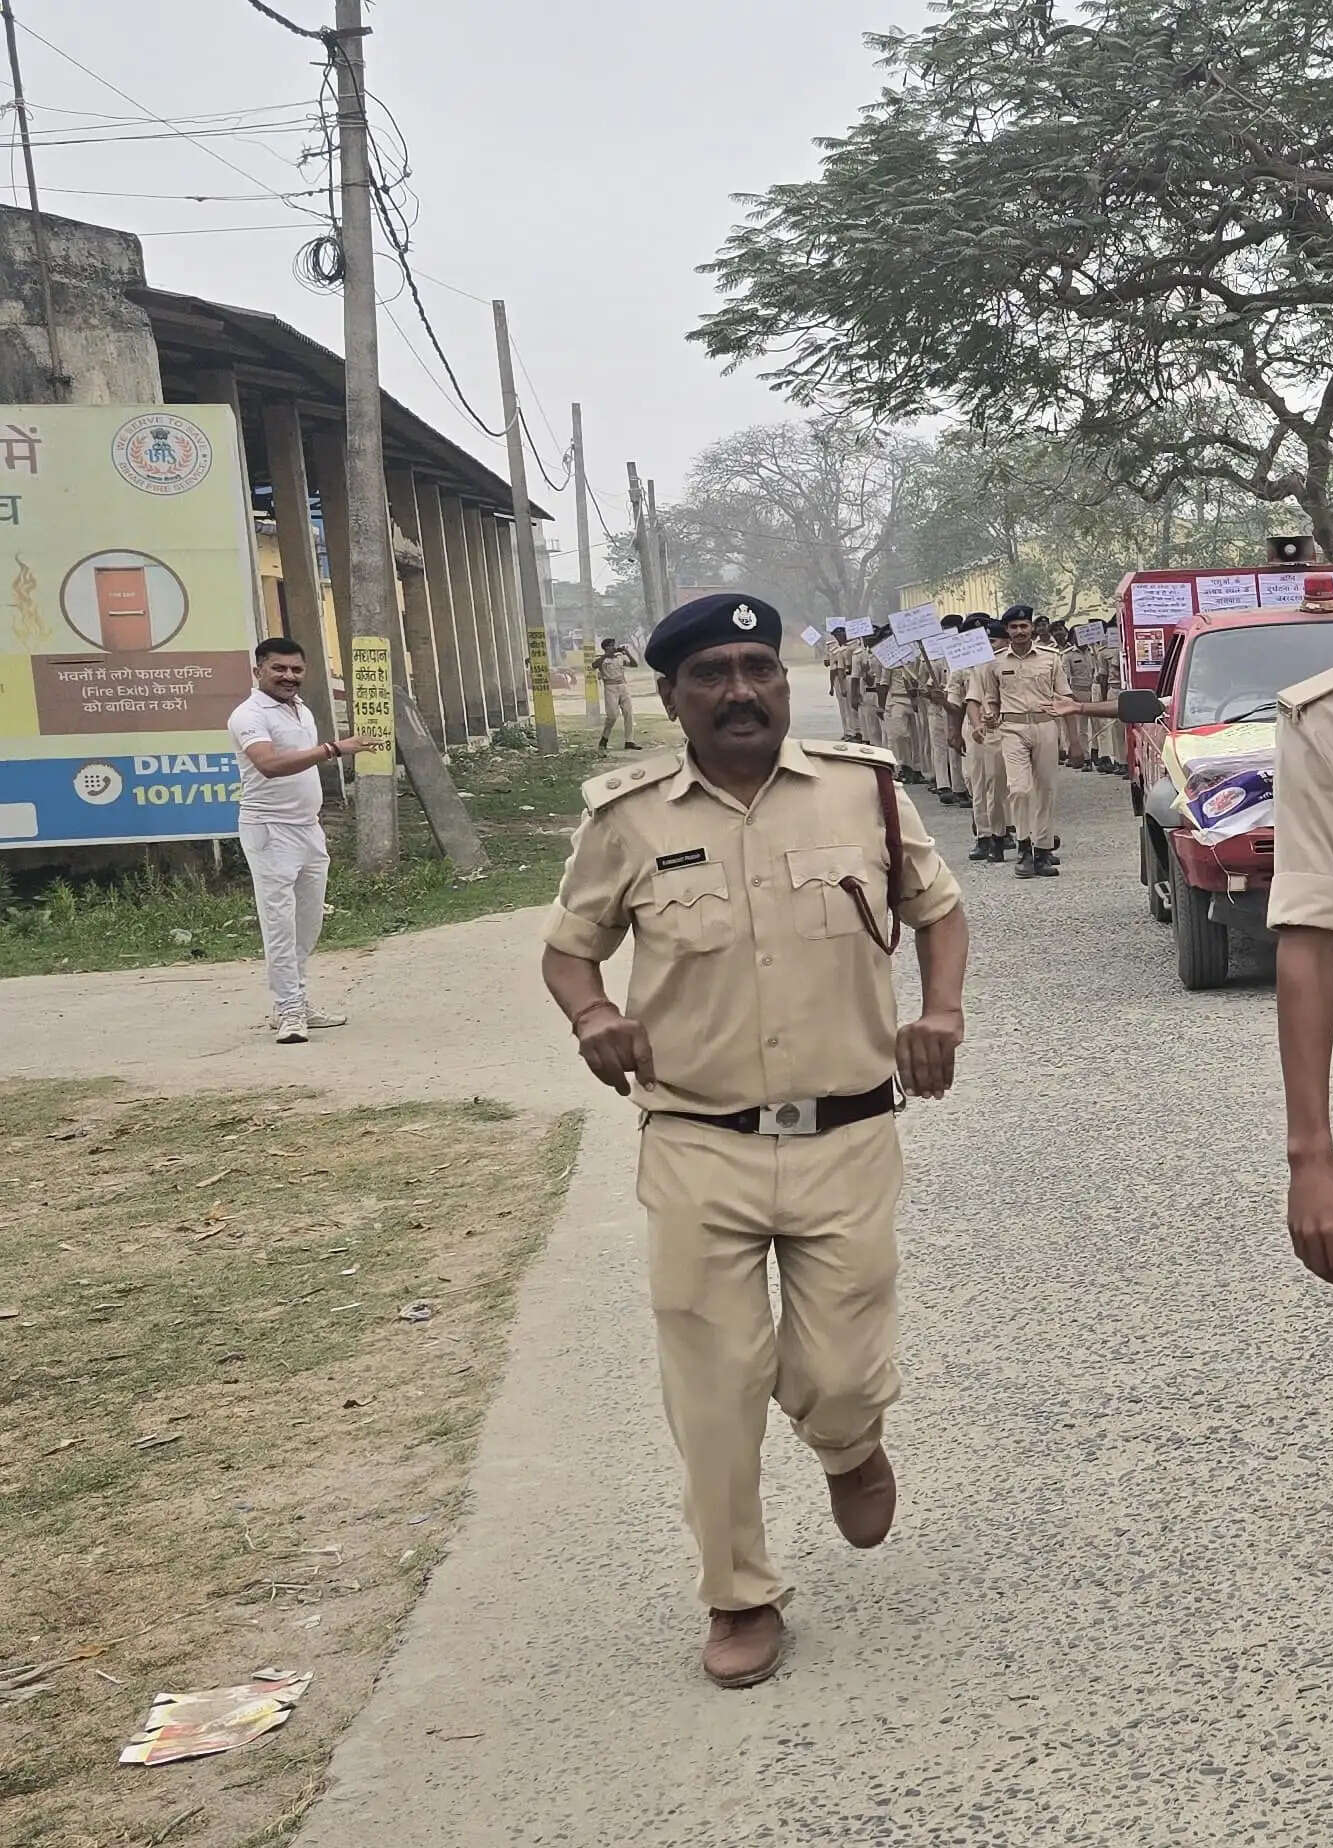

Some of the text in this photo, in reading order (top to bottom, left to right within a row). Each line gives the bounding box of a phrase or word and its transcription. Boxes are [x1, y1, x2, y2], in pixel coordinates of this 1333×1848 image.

[58, 665, 214, 682] भवनों में लगे फायर एग्जिट
[81, 680, 195, 698] (Fire Exit) के मार्ग
[83, 699, 104, 714] को
[105, 698, 146, 713] बाधित
[148, 700, 160, 712] न
[355, 702, 390, 716] 15545
